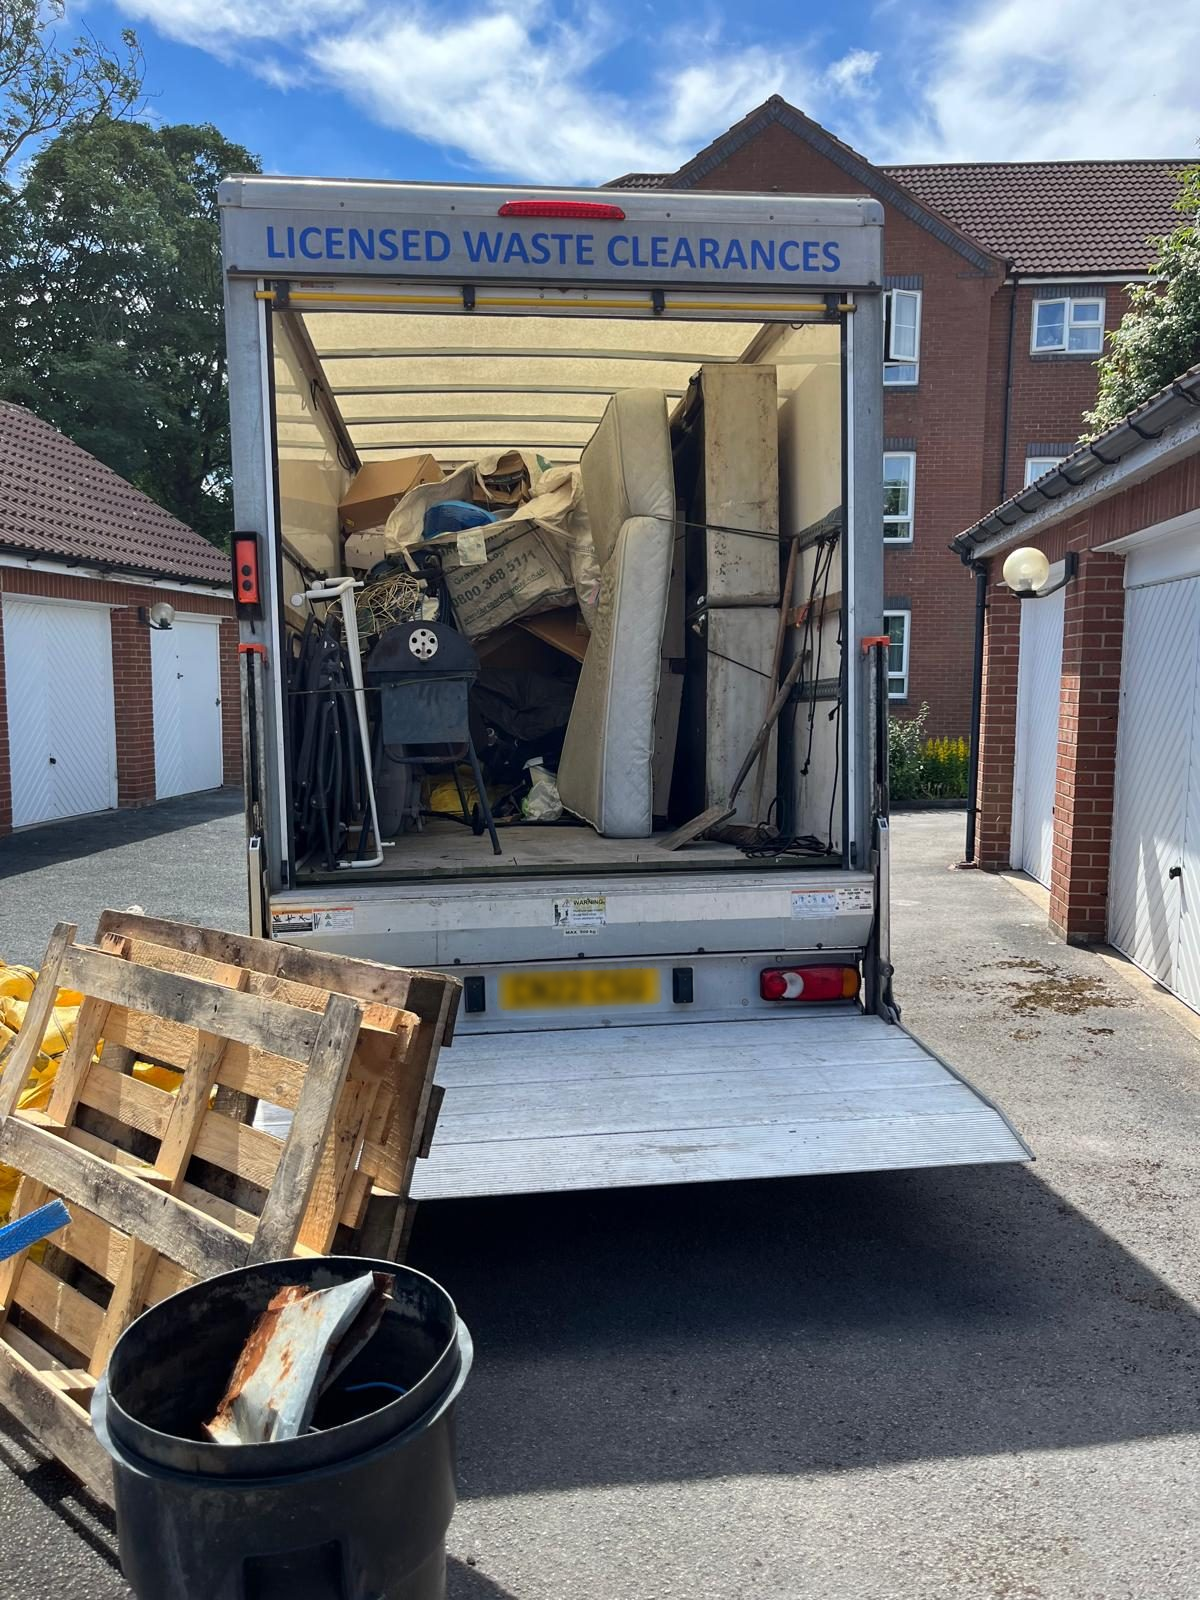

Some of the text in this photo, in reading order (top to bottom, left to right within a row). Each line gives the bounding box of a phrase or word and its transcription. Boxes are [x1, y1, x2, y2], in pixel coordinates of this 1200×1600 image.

[266, 225, 841, 273] LICENSED WASTE CLEARANCES
[451, 550, 537, 609] 0800 368 5111
